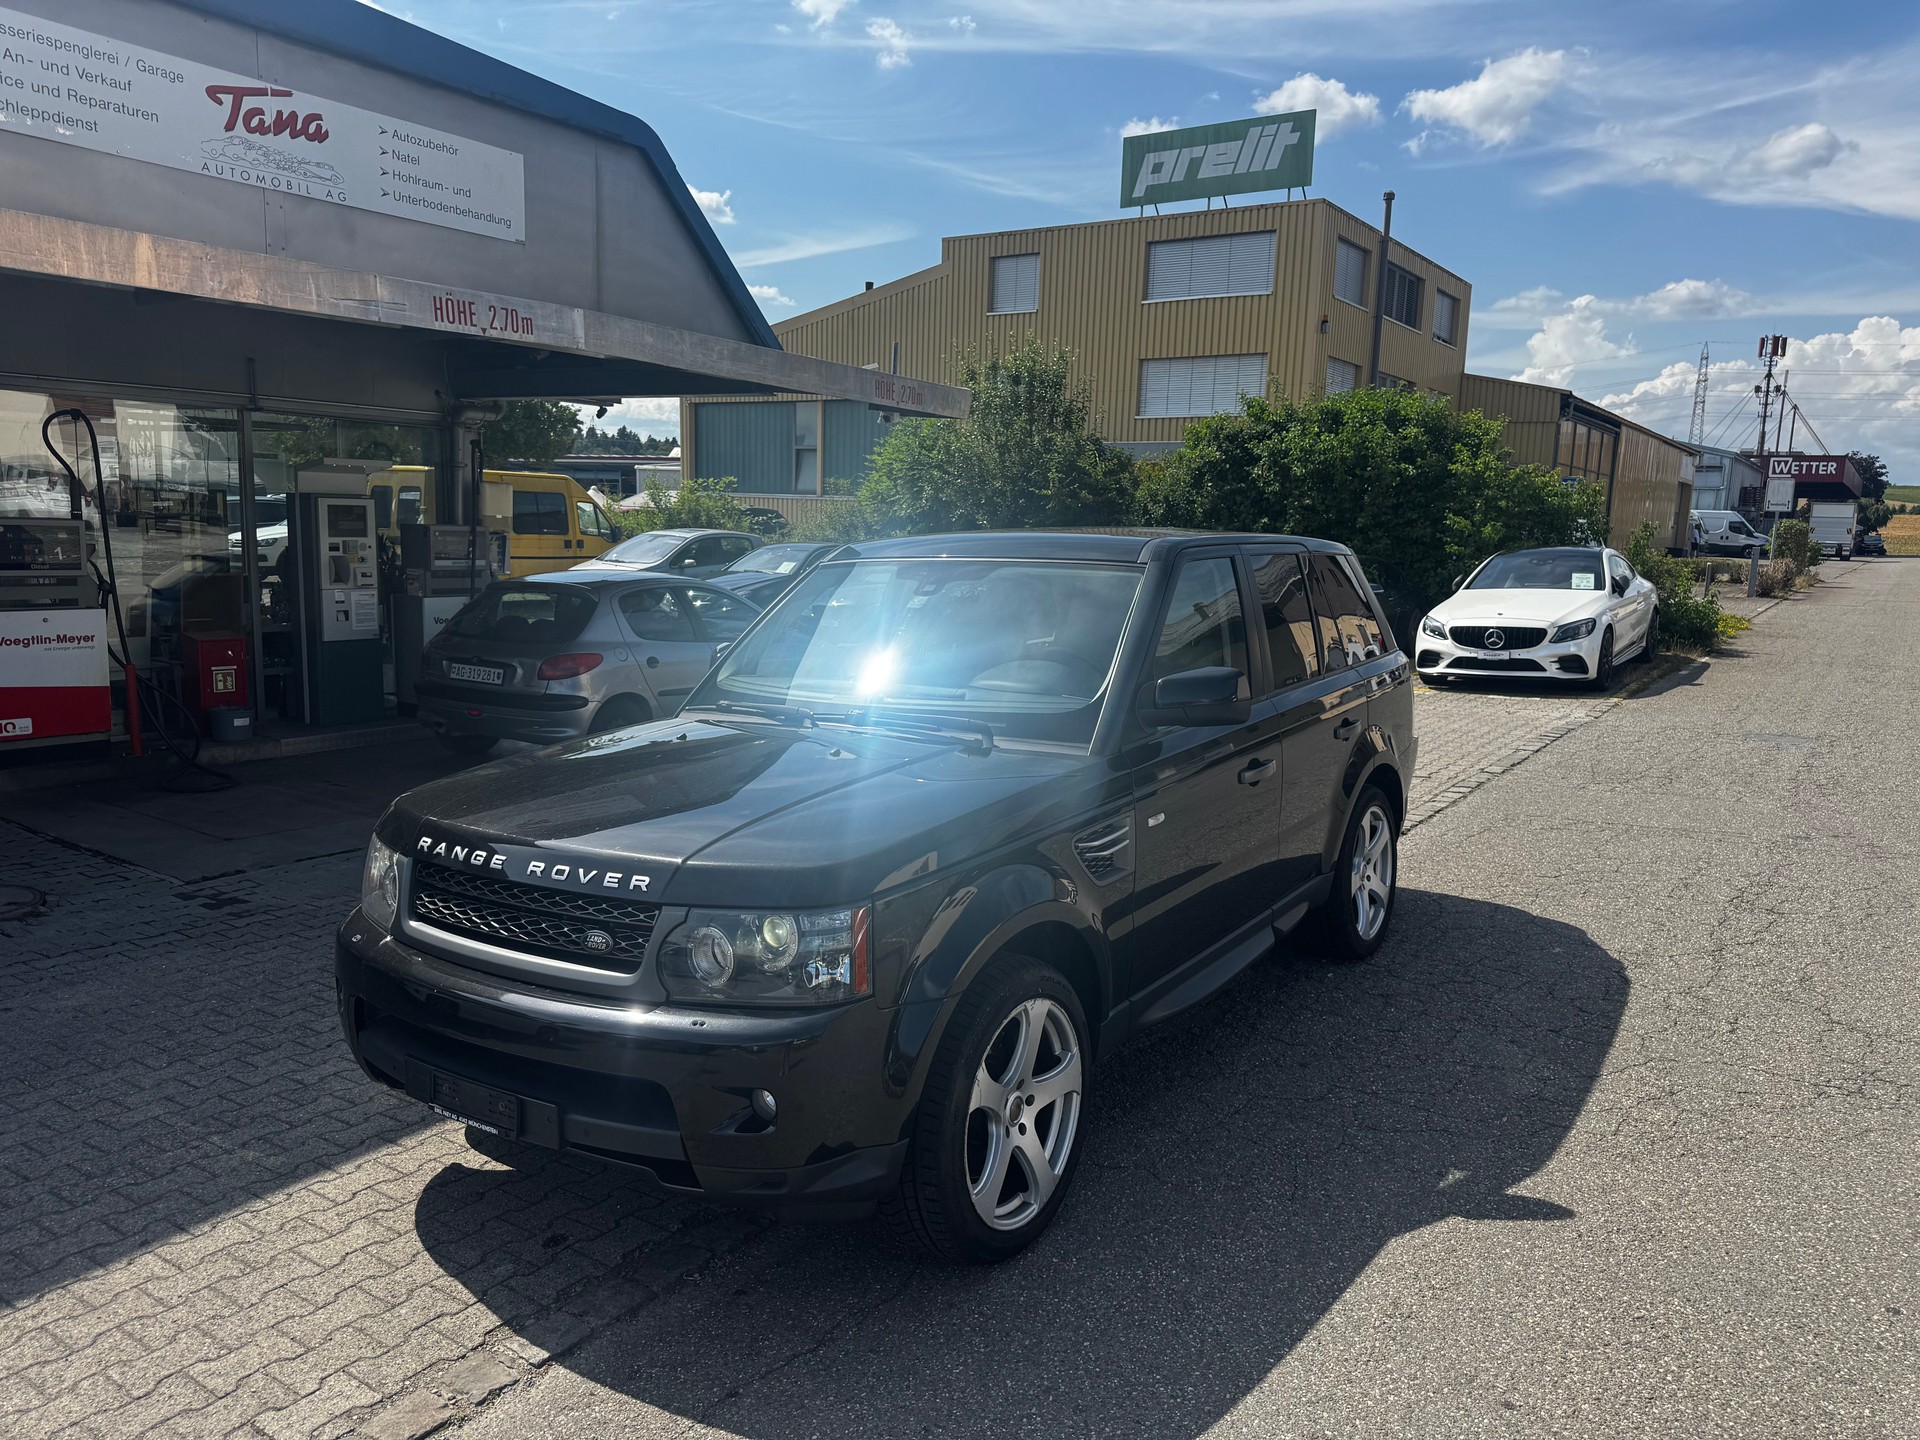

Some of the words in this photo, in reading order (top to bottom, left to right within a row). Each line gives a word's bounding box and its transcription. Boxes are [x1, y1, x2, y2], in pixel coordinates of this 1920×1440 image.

[3, 47, 34, 65] An-
[41, 59, 69, 76] und
[75, 65, 132, 92] Verkauf
[136, 59, 184, 83] Garage
[31, 82, 60, 98] und
[67, 88, 159, 123] Reparaturen
[205, 85, 329, 144] Tana
[392, 129, 459, 156] Autozubehör
[392, 149, 420, 166] Natel
[1132, 122, 1300, 198] prelit
[201, 162, 311, 195] AUTOMOBIL
[326, 189, 347, 202] AG
[392, 169, 449, 191] Hohlraum-
[452, 186, 472, 198] und
[393, 190, 512, 229] Unterbodenbehandlung
[433, 292, 477, 328] HÖHE
[874, 377, 895, 401] HÖHE
[1772, 459, 1837, 475] WETTER
[54, 546, 63, 560] 1
[417, 836, 508, 870] RANGE
[526, 861, 651, 892] ROVER
[586, 934, 602, 943] LAND
[587, 941, 606, 950] ROVER
